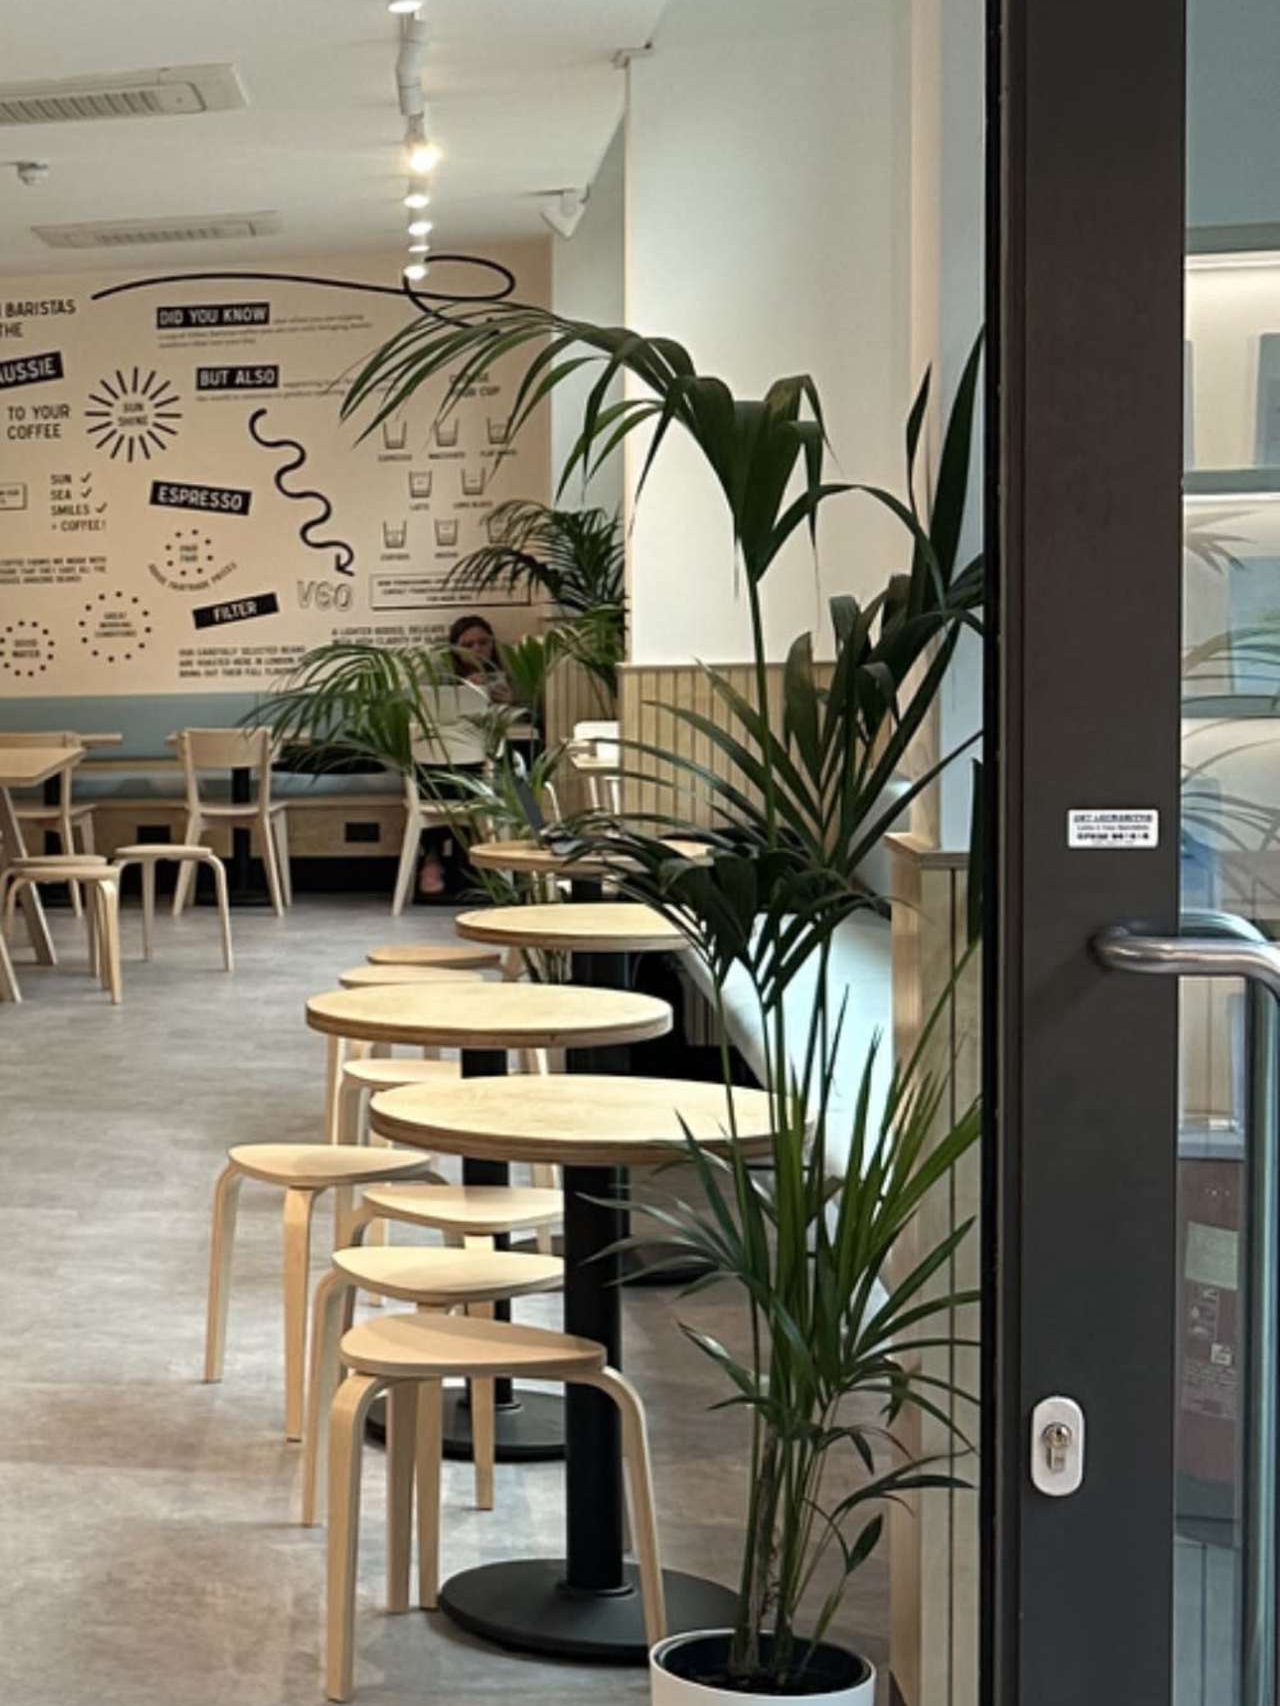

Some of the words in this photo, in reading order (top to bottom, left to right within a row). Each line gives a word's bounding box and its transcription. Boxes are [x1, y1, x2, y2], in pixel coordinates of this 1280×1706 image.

[5, 298, 77, 319] BARISTAS
[159, 308, 184, 326] DID
[189, 307, 219, 325] YOU
[222, 305, 267, 324] KNOW
[199, 370, 228, 387] BUT
[235, 368, 276, 386] ALSO
[7, 405, 26, 421] TO
[31, 403, 71, 420] YOUR
[7, 423, 62, 440] COFFEE
[50, 473, 72, 485] SUN
[50, 488, 72, 501] SEA
[158, 485, 243, 511] ESPRESSO
[50, 503, 90, 517] SMILES
[212, 601, 258, 622] FILTER
